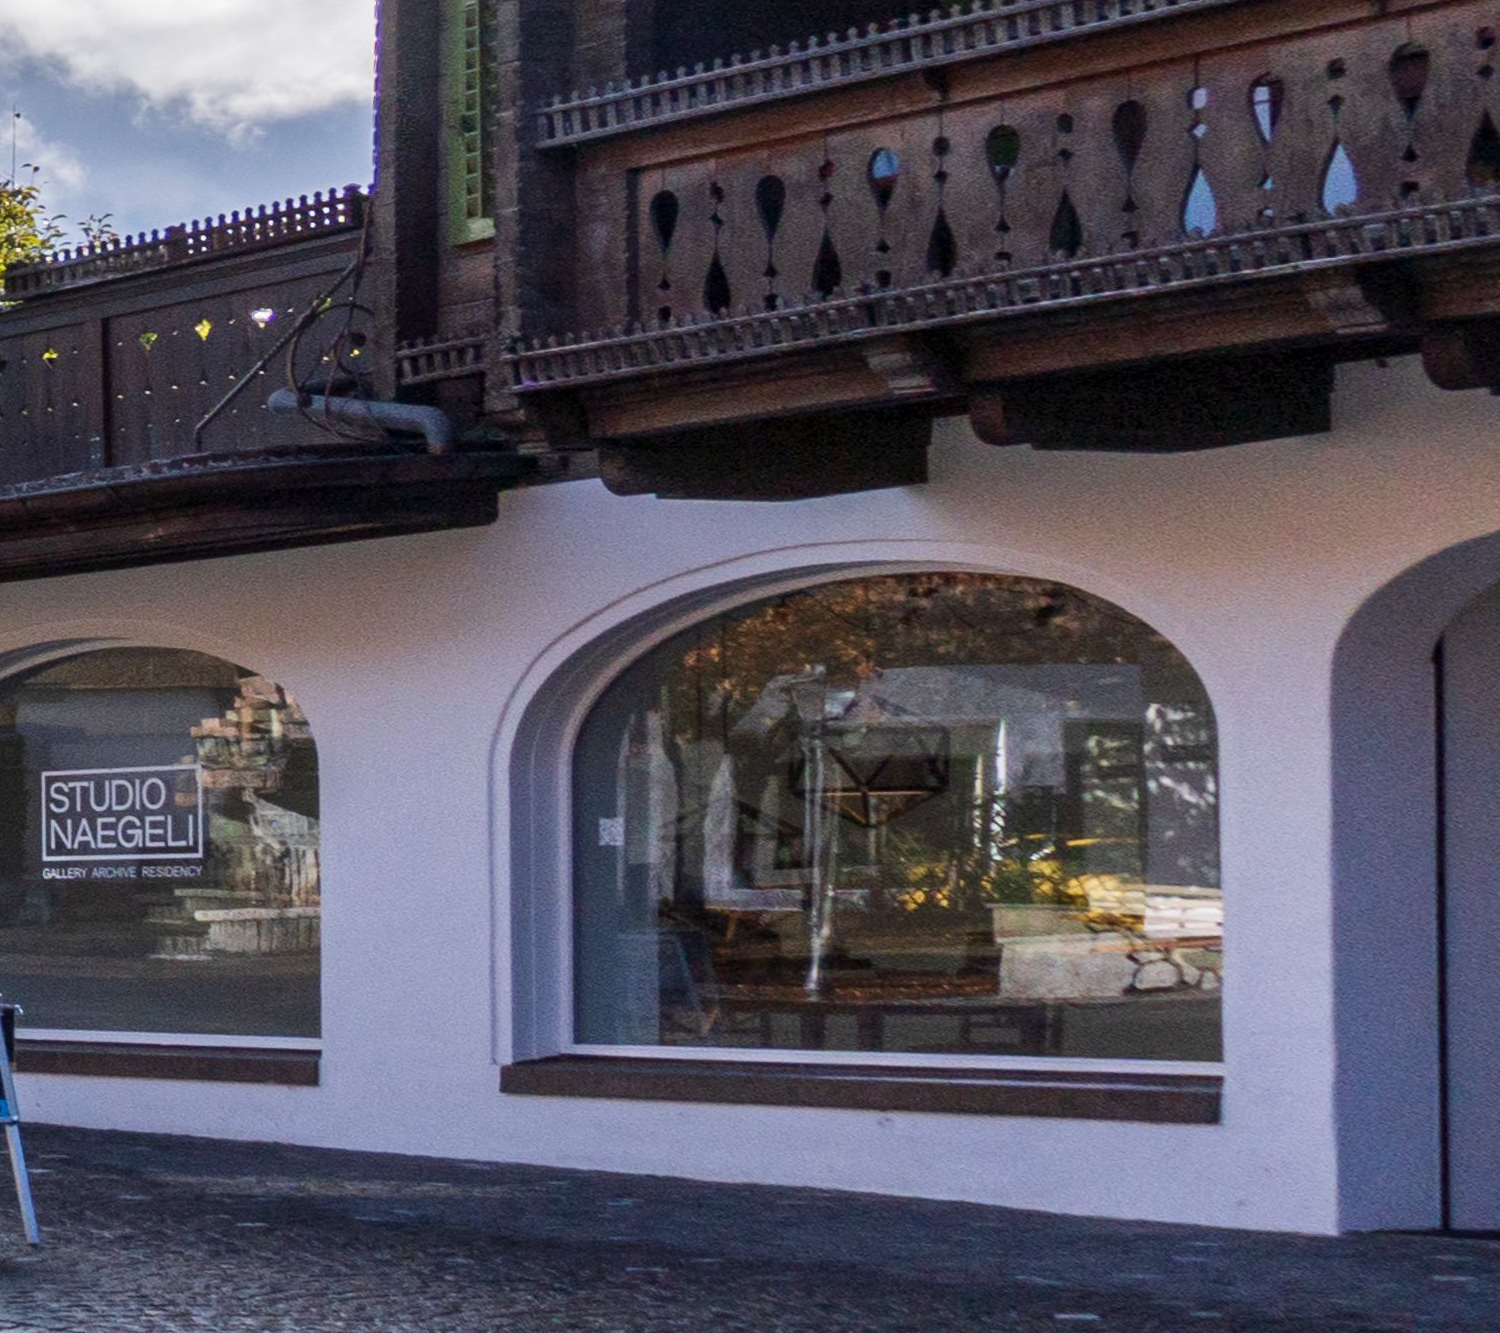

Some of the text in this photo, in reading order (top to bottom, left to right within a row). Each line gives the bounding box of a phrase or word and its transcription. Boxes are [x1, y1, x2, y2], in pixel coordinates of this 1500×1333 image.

[49, 778, 166, 813] STUDIO
[51, 814, 194, 849] NAEGELI
[43, 865, 202, 879] GALLERY ARCHIVE RESIDENCY
